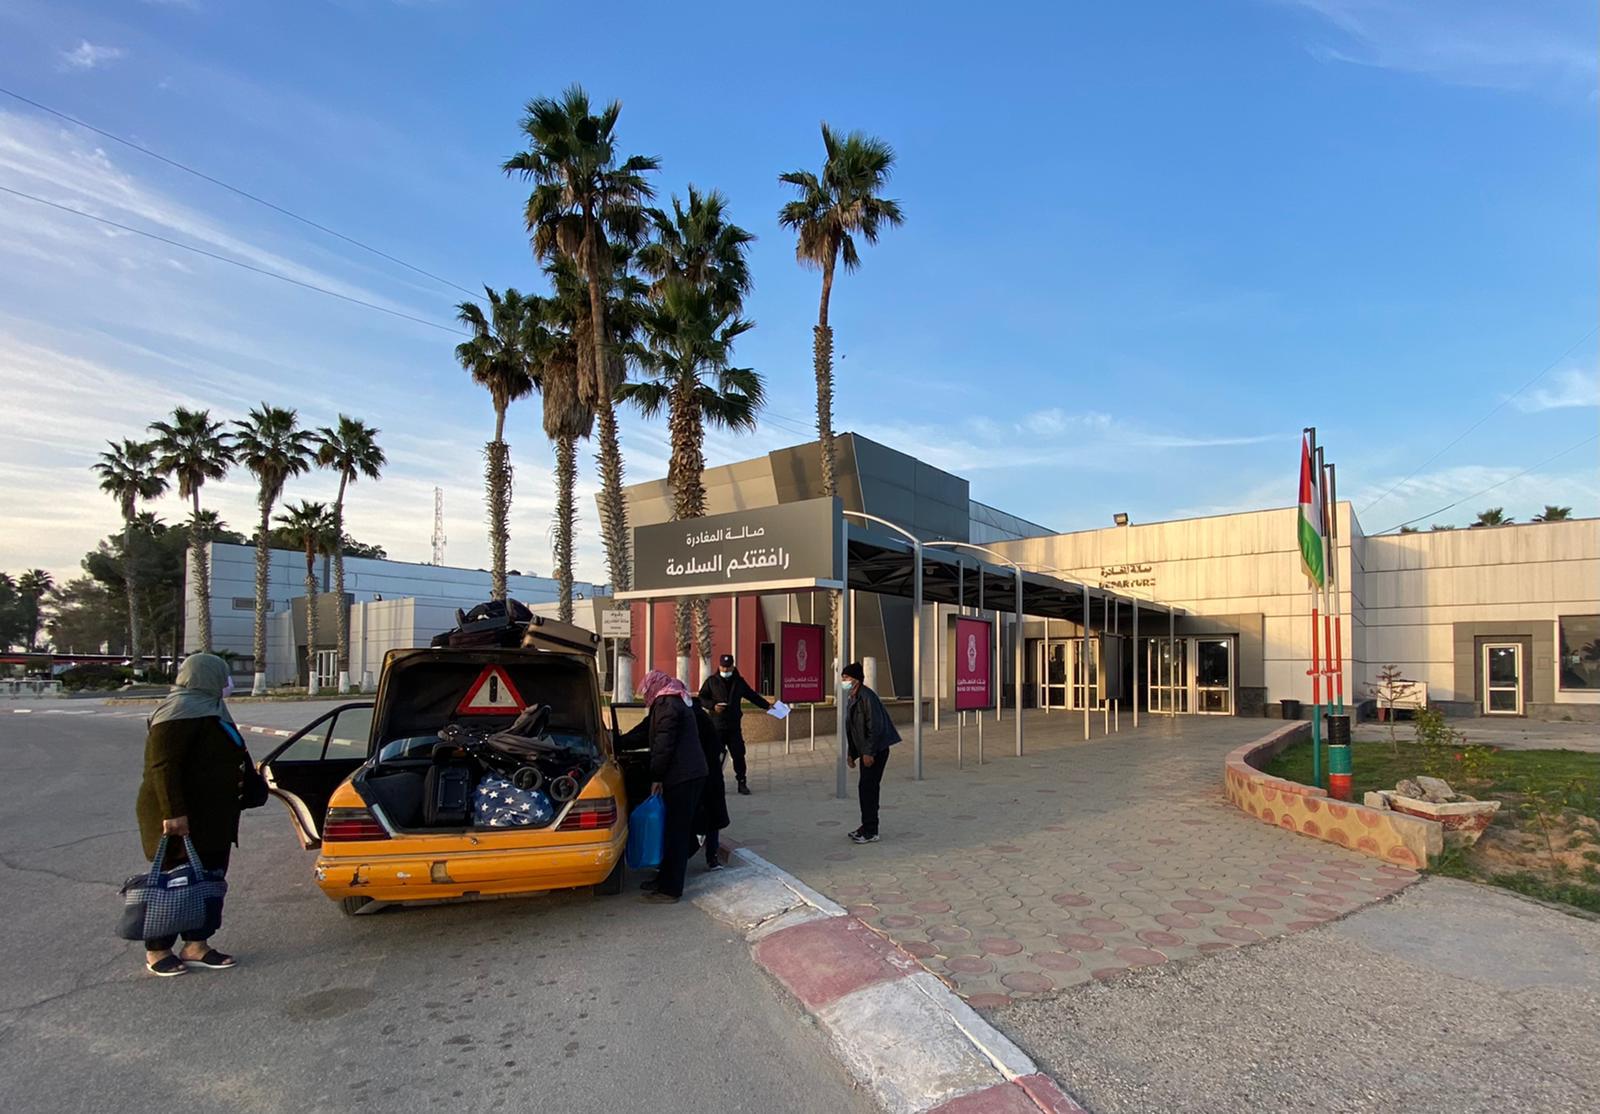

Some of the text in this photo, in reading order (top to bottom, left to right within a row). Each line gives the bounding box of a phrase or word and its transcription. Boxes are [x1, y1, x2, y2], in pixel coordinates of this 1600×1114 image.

[686, 529, 723, 547] المغادرة
[666, 547, 790, 578] رافقتكم السلامة
